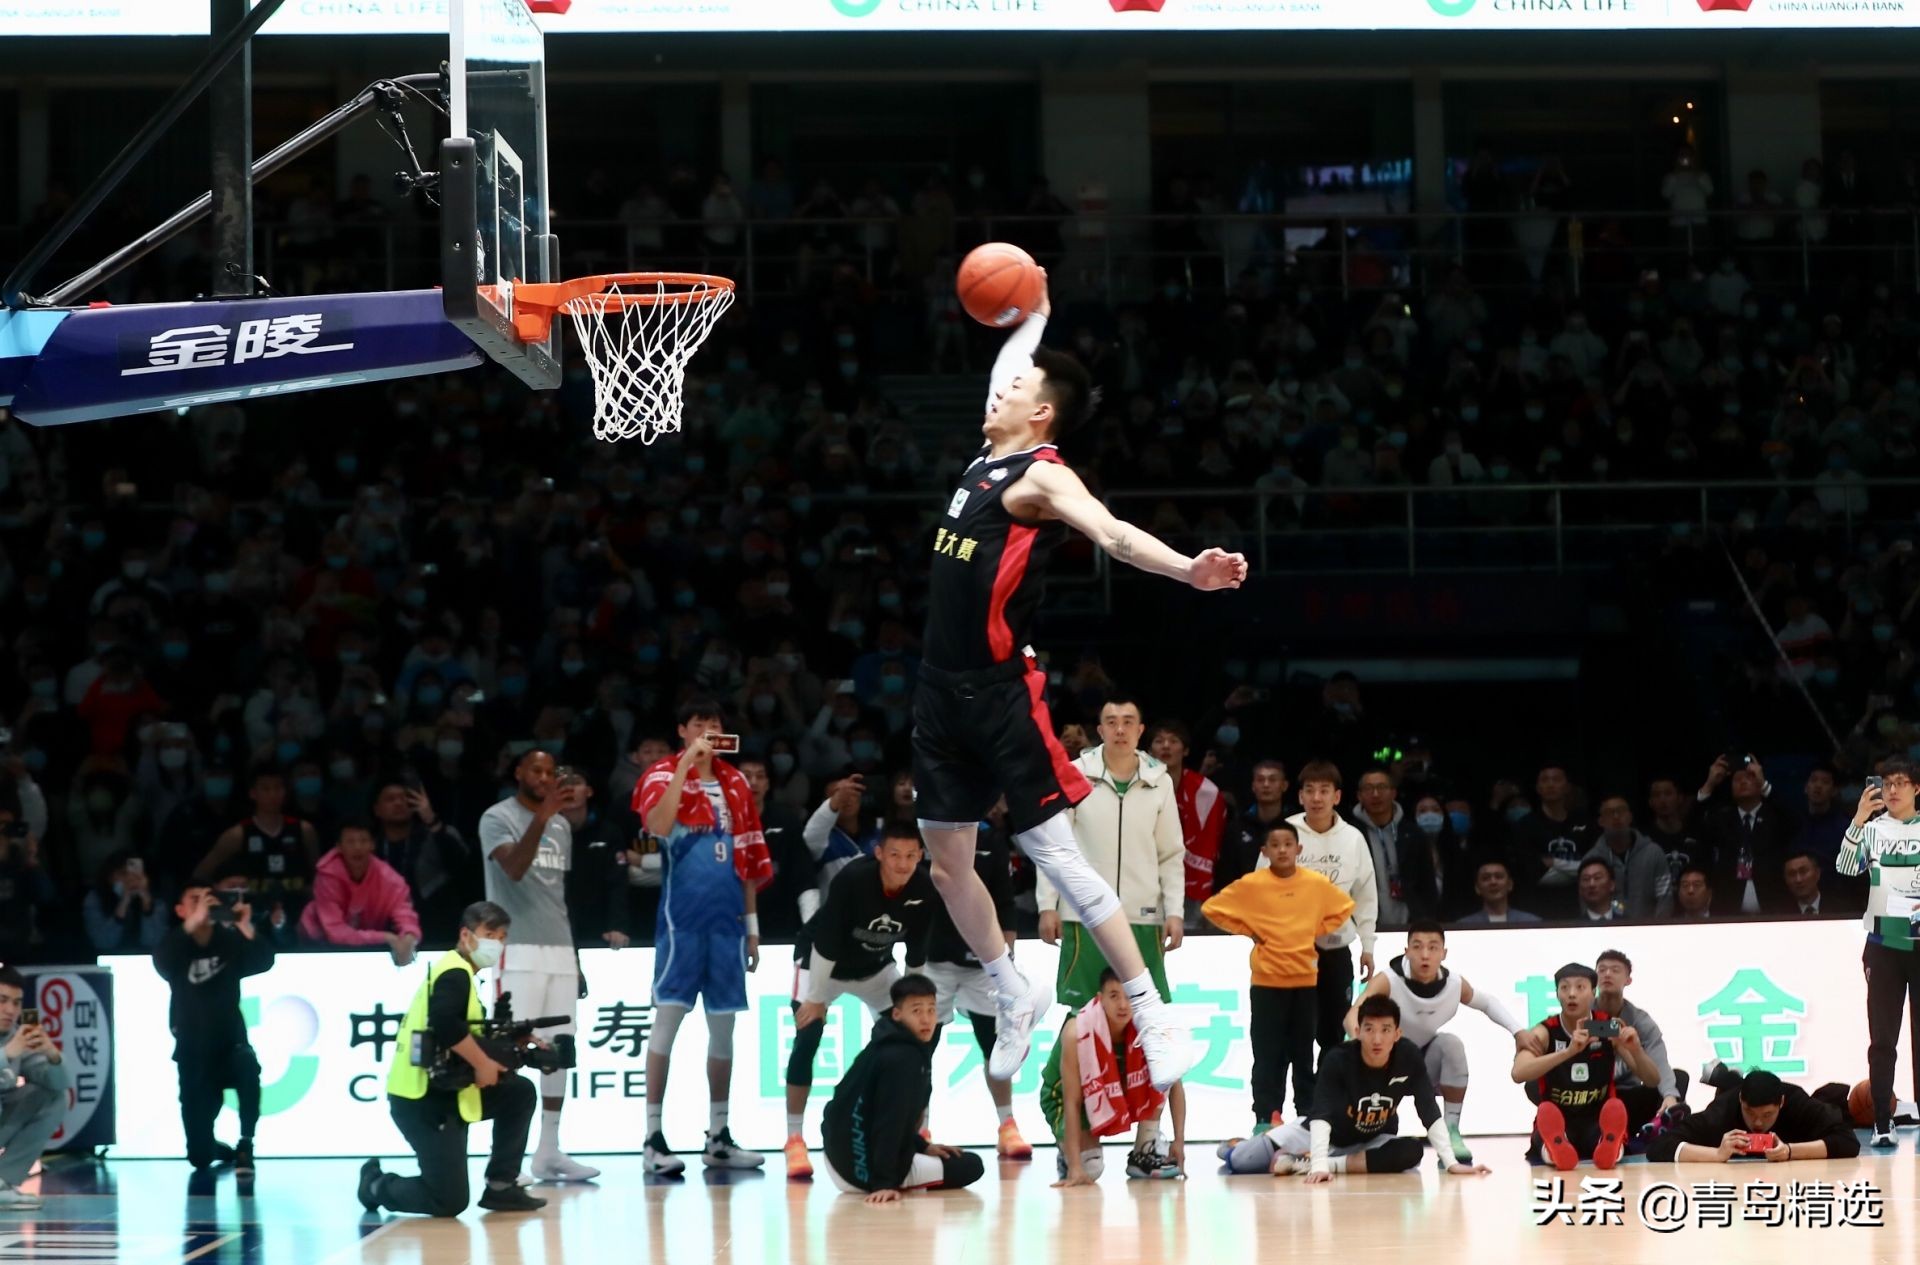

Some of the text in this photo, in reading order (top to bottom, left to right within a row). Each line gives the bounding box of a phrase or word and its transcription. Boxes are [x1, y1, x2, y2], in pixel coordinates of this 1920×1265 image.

[899, 0, 1046, 12] CHINA LIFE
[1493, 0, 1636, 12] CHINA LIFE
[1769, 0, 1808, 12] CHINA
[1872, 0, 1905, 12] BANK
[121, 313, 354, 376] 金陵
[714, 841, 728, 862] 9
[74, 1001, 99, 1103] 百岁山
[572, 1071, 646, 1098] IFE
